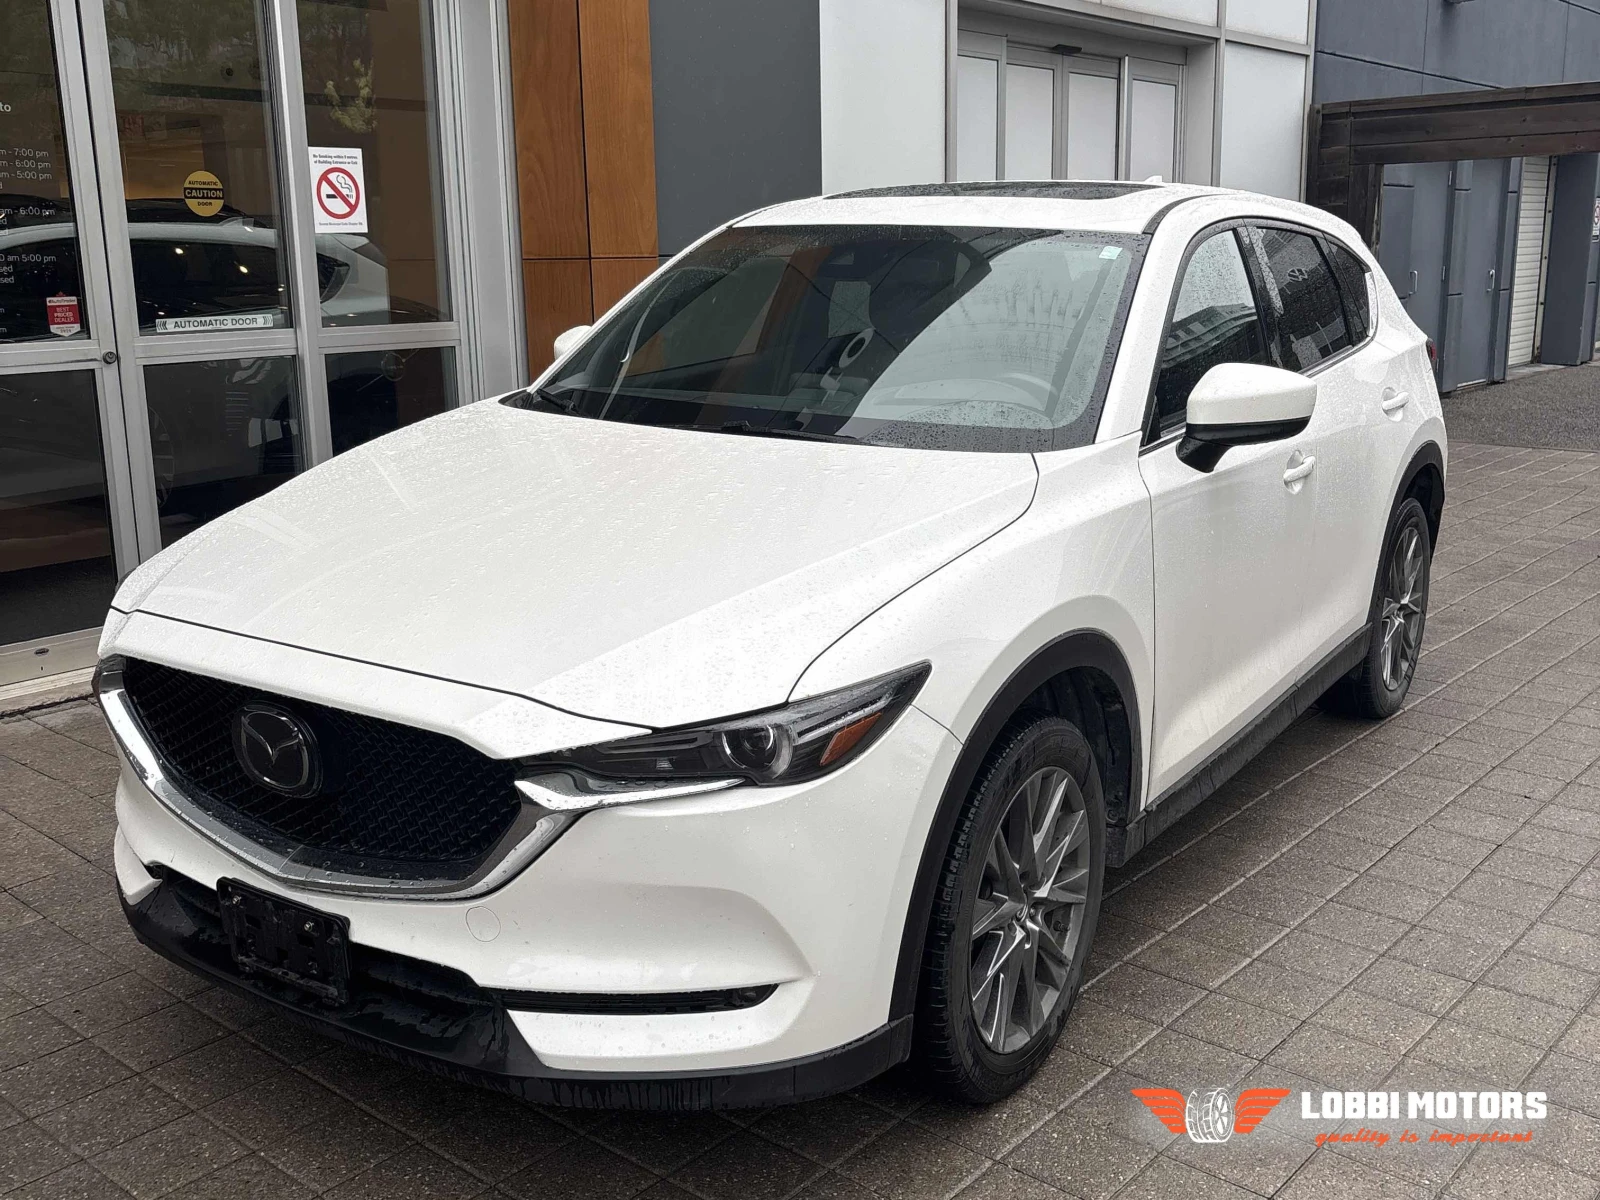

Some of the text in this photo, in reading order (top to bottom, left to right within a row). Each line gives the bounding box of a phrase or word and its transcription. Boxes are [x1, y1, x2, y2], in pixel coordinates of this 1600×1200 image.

[13, 147, 34, 157] 7:00
[35, 150, 49, 158] pm
[15, 159, 36, 168] 6:00
[16, 170, 37, 179] 5:00
[38, 173, 52, 181] pm
[185, 189, 223, 198] CAUTION
[20, 206, 40, 216] 6:00
[21, 253, 42, 262] 5:00
[43, 255, 57, 263] pm
[173, 317, 258, 329] AUTOMATIC DOOR
